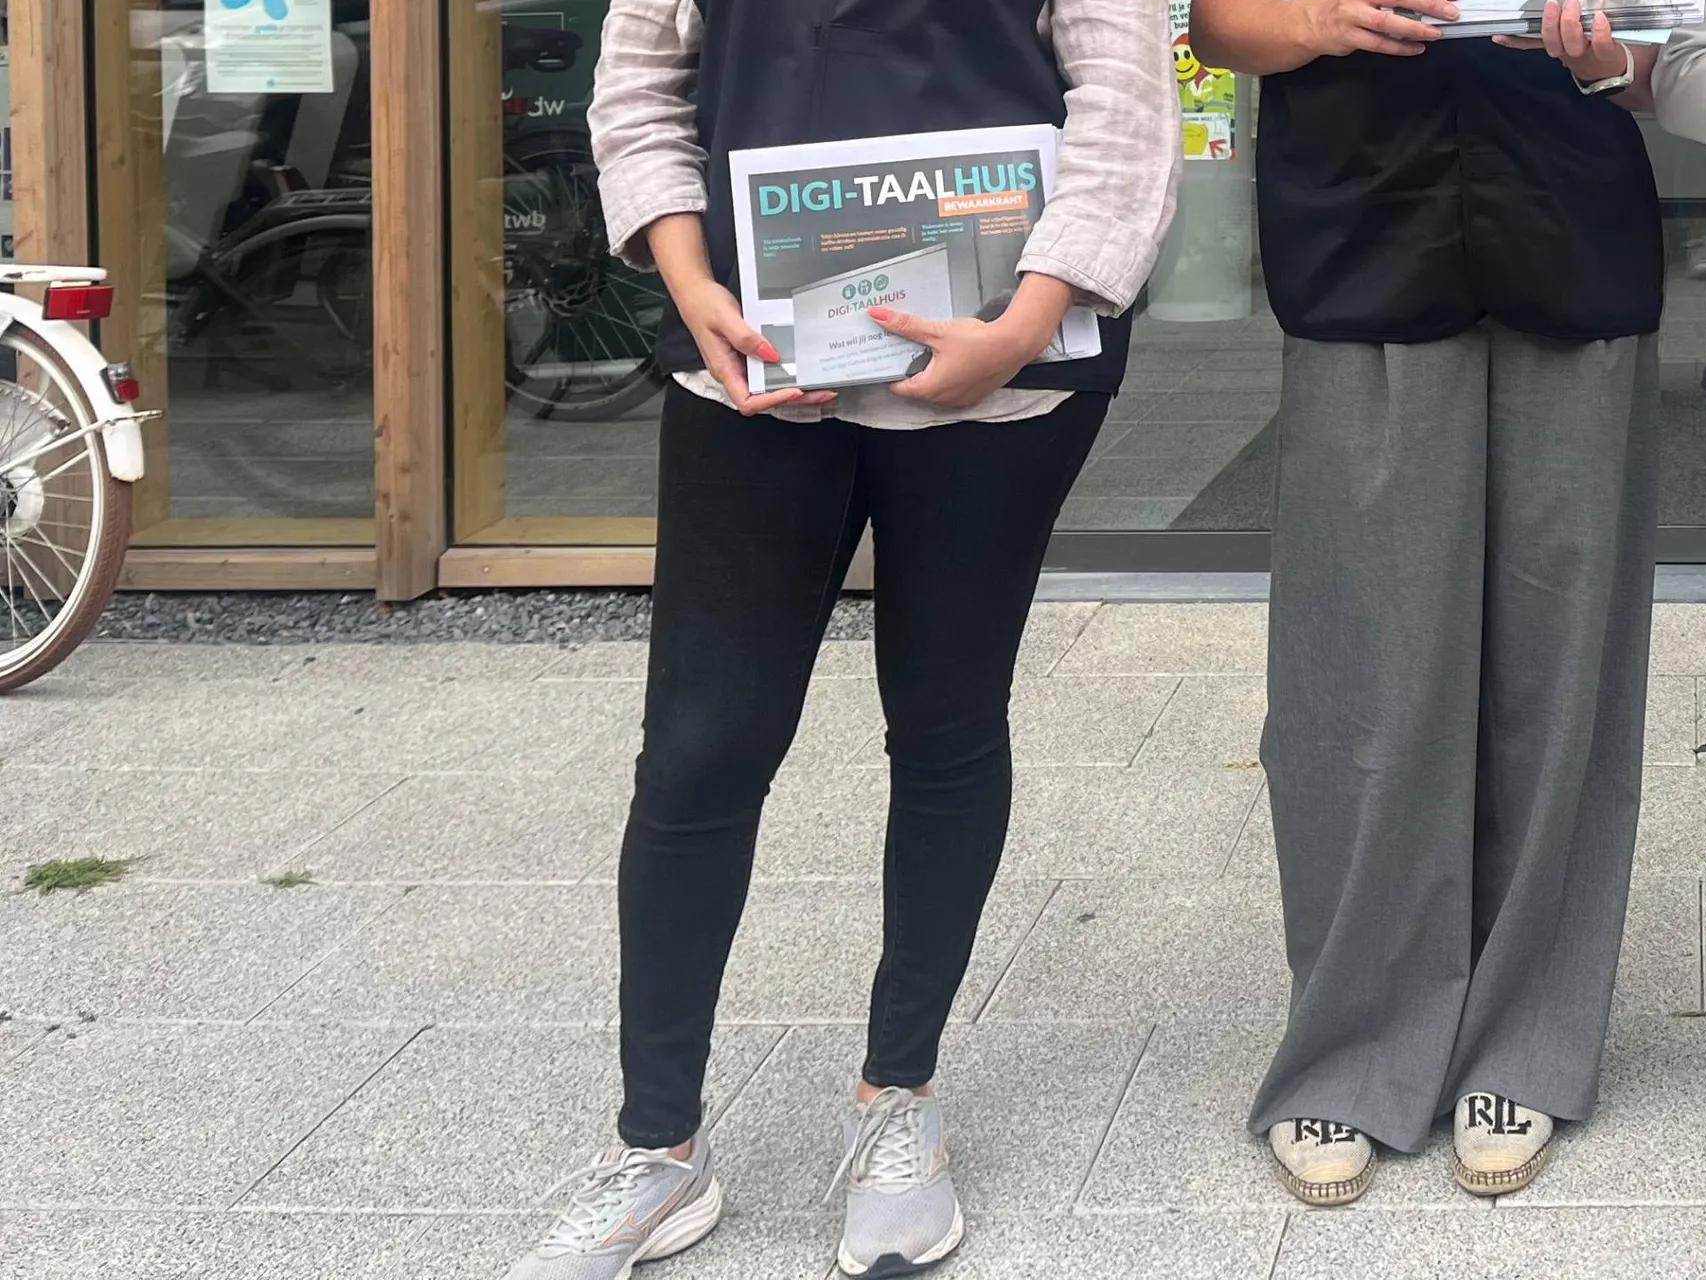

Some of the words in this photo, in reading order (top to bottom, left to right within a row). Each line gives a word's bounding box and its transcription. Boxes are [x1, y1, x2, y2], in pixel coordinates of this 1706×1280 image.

[1174, 21, 1188, 29] buu
[527, 96, 565, 116] dw
[758, 161, 1037, 216] DIGI-TAALHUIS
[944, 194, 1024, 212] BEWAARKRANT
[504, 210, 546, 229] twb
[827, 289, 907, 320] DIGI-TAALHUIS
[829, 341, 845, 351] Wat
[868, 331, 883, 342] nog
